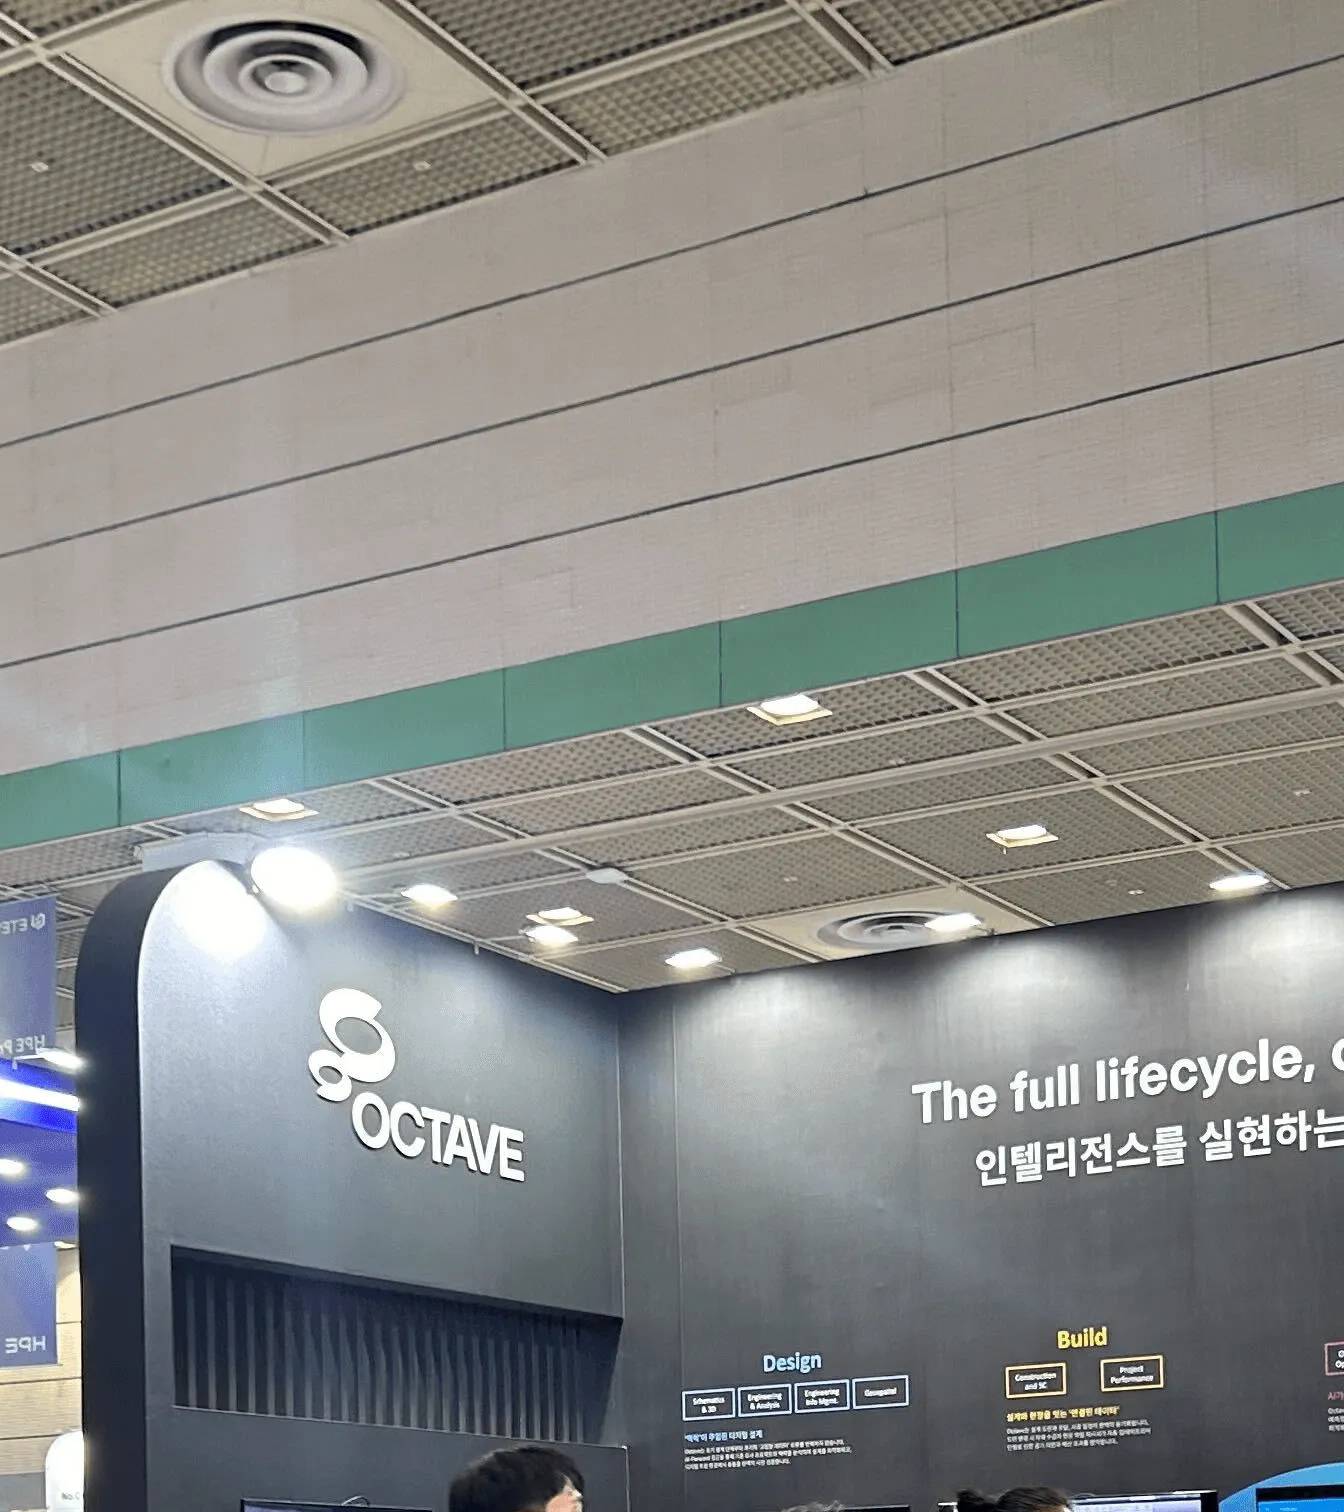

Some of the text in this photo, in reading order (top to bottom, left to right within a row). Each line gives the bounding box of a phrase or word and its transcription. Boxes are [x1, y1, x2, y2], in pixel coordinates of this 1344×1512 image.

[911, 1080, 997, 1124] The
[1009, 1064, 1080, 1112] full
[1096, 1038, 1315, 1102] lifecycle,
[351, 1092, 525, 1181] OCTAVE
[975, 1125, 1187, 1187] 인텔리전스를
[763, 1352, 822, 1374] Design
[1057, 1326, 1108, 1350] Build
